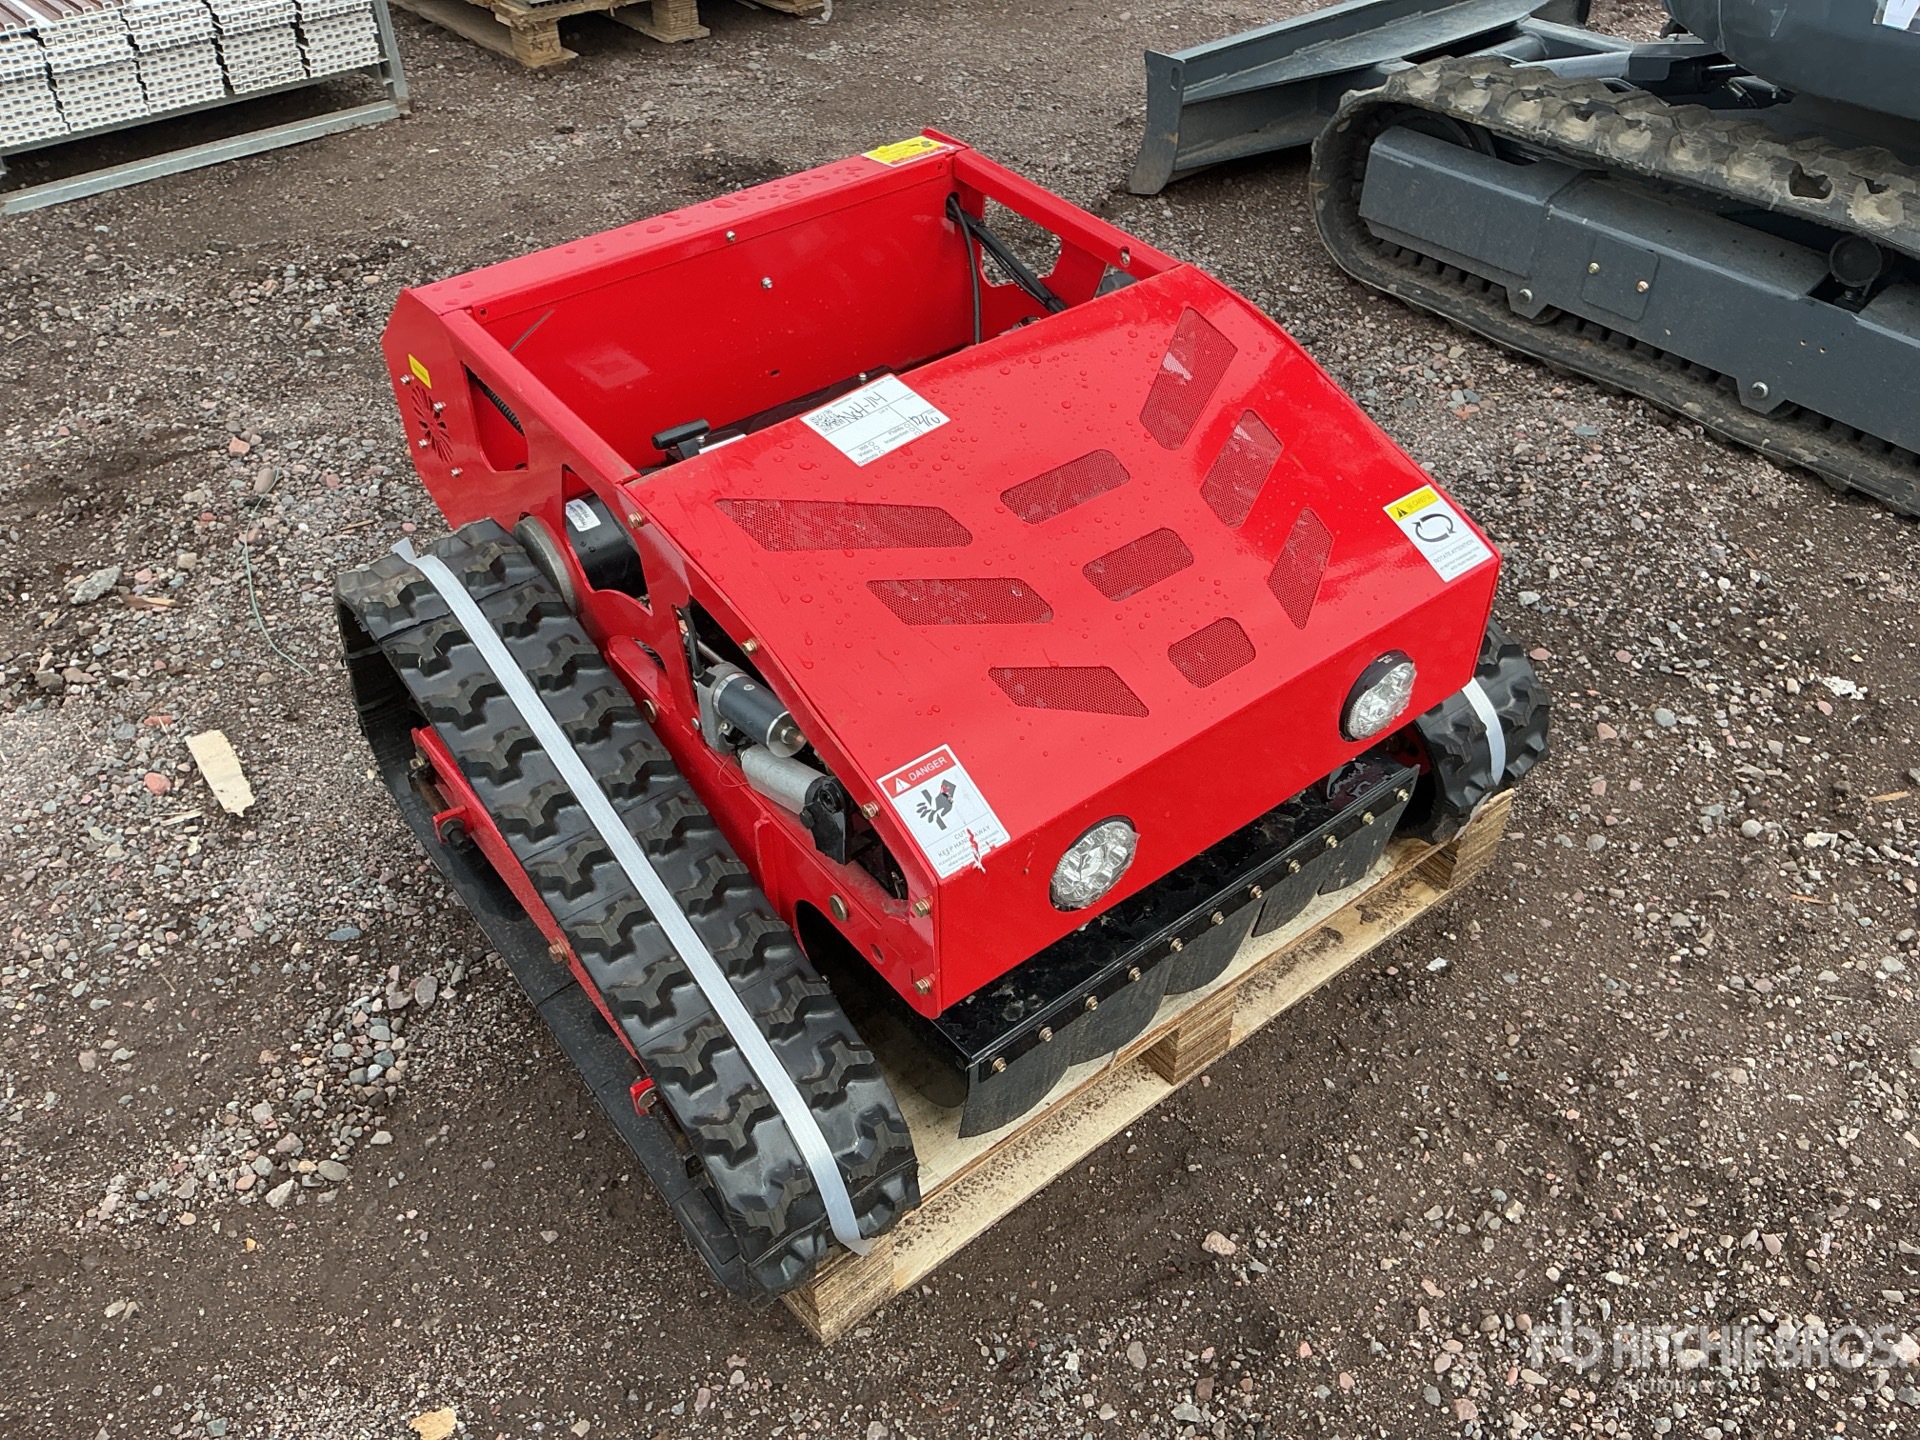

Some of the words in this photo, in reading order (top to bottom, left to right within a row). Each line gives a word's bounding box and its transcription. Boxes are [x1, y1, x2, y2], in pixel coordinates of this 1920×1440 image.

[908, 756, 947, 781] DANGER
[954, 830, 966, 839] CUT
[974, 825, 991, 837] AWAY
